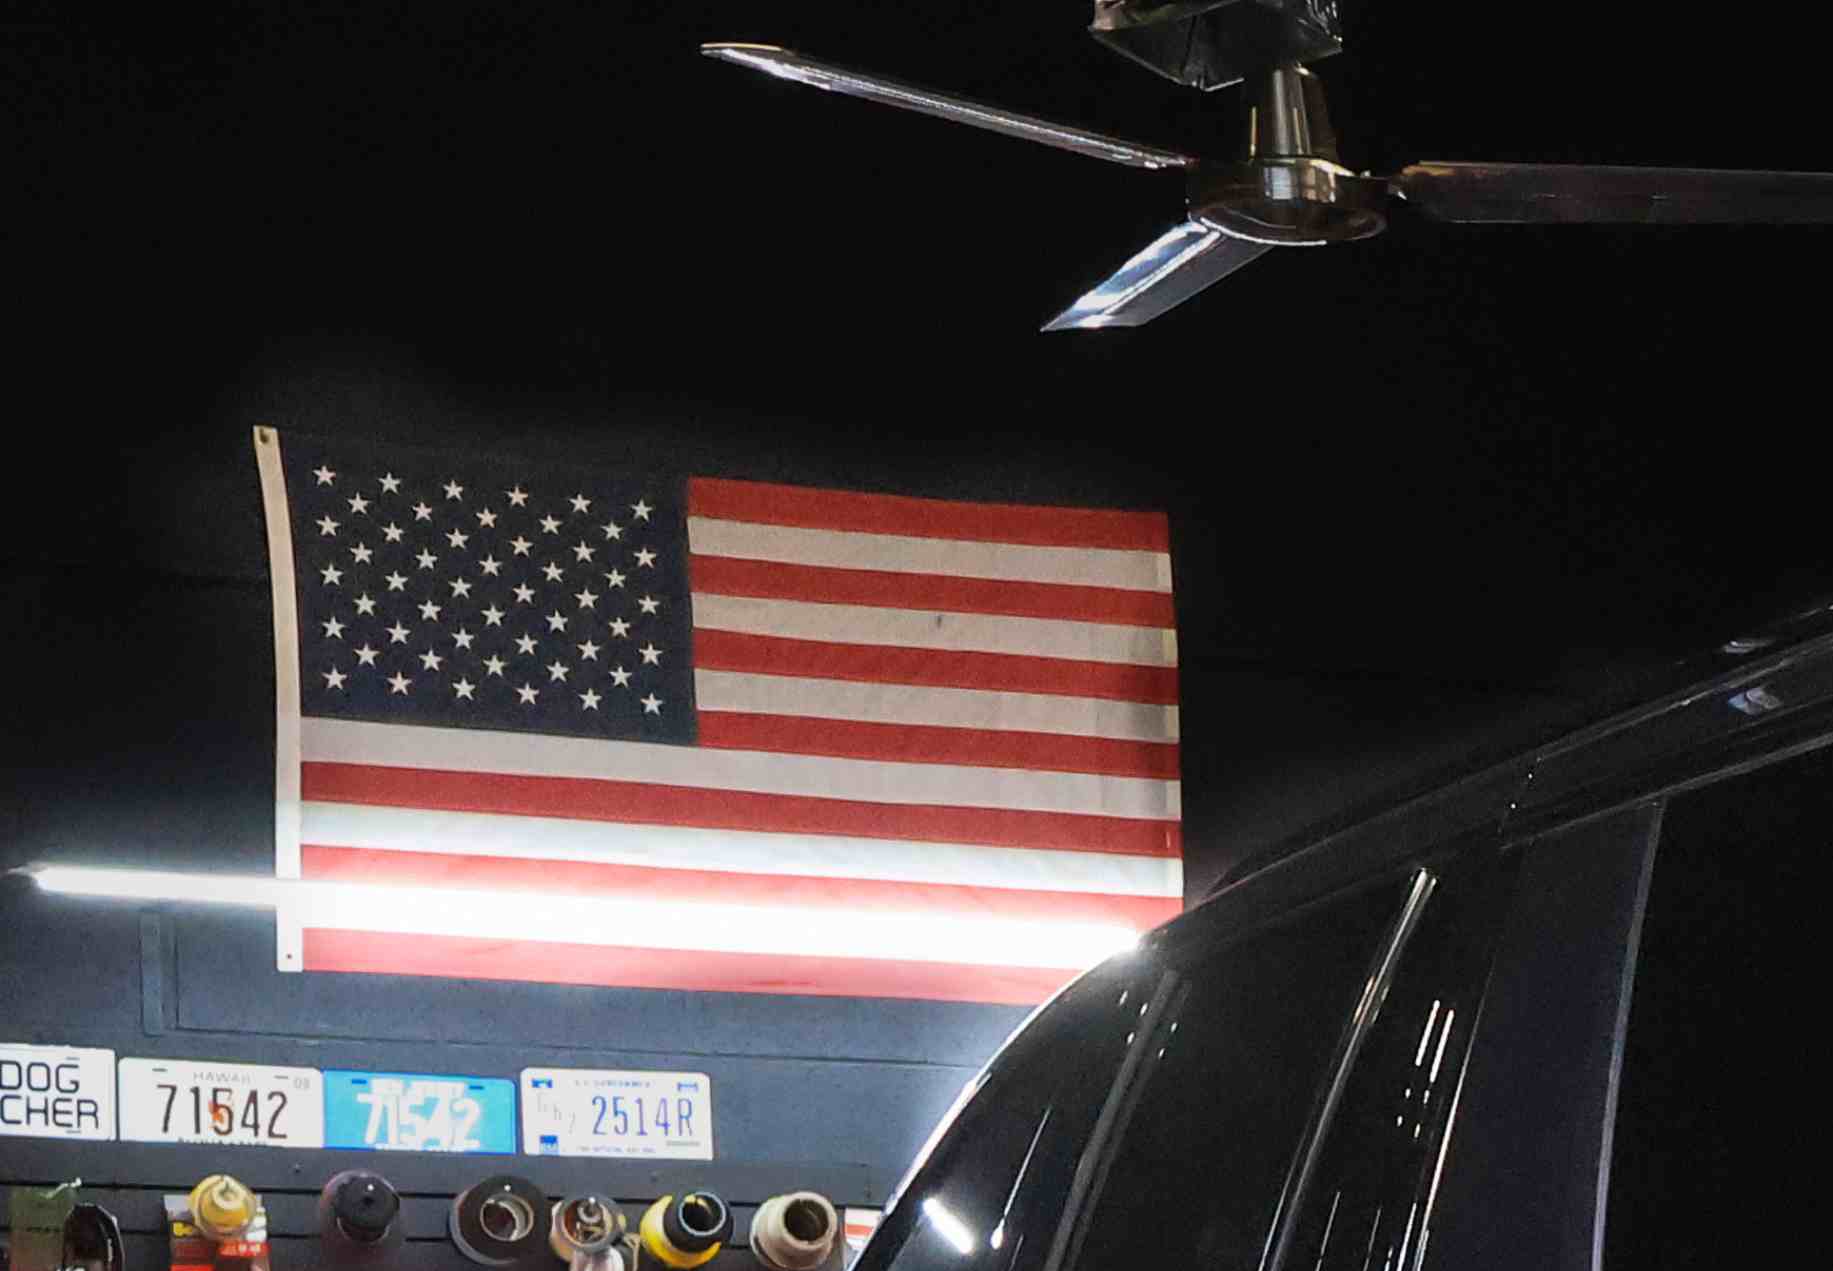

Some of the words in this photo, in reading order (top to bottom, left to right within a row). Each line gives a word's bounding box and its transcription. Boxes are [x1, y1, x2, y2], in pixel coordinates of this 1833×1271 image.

[0, 1060, 80, 1094] DOG
[156, 1083, 288, 1139] 71542
[591, 1095, 693, 1137] 2514R
